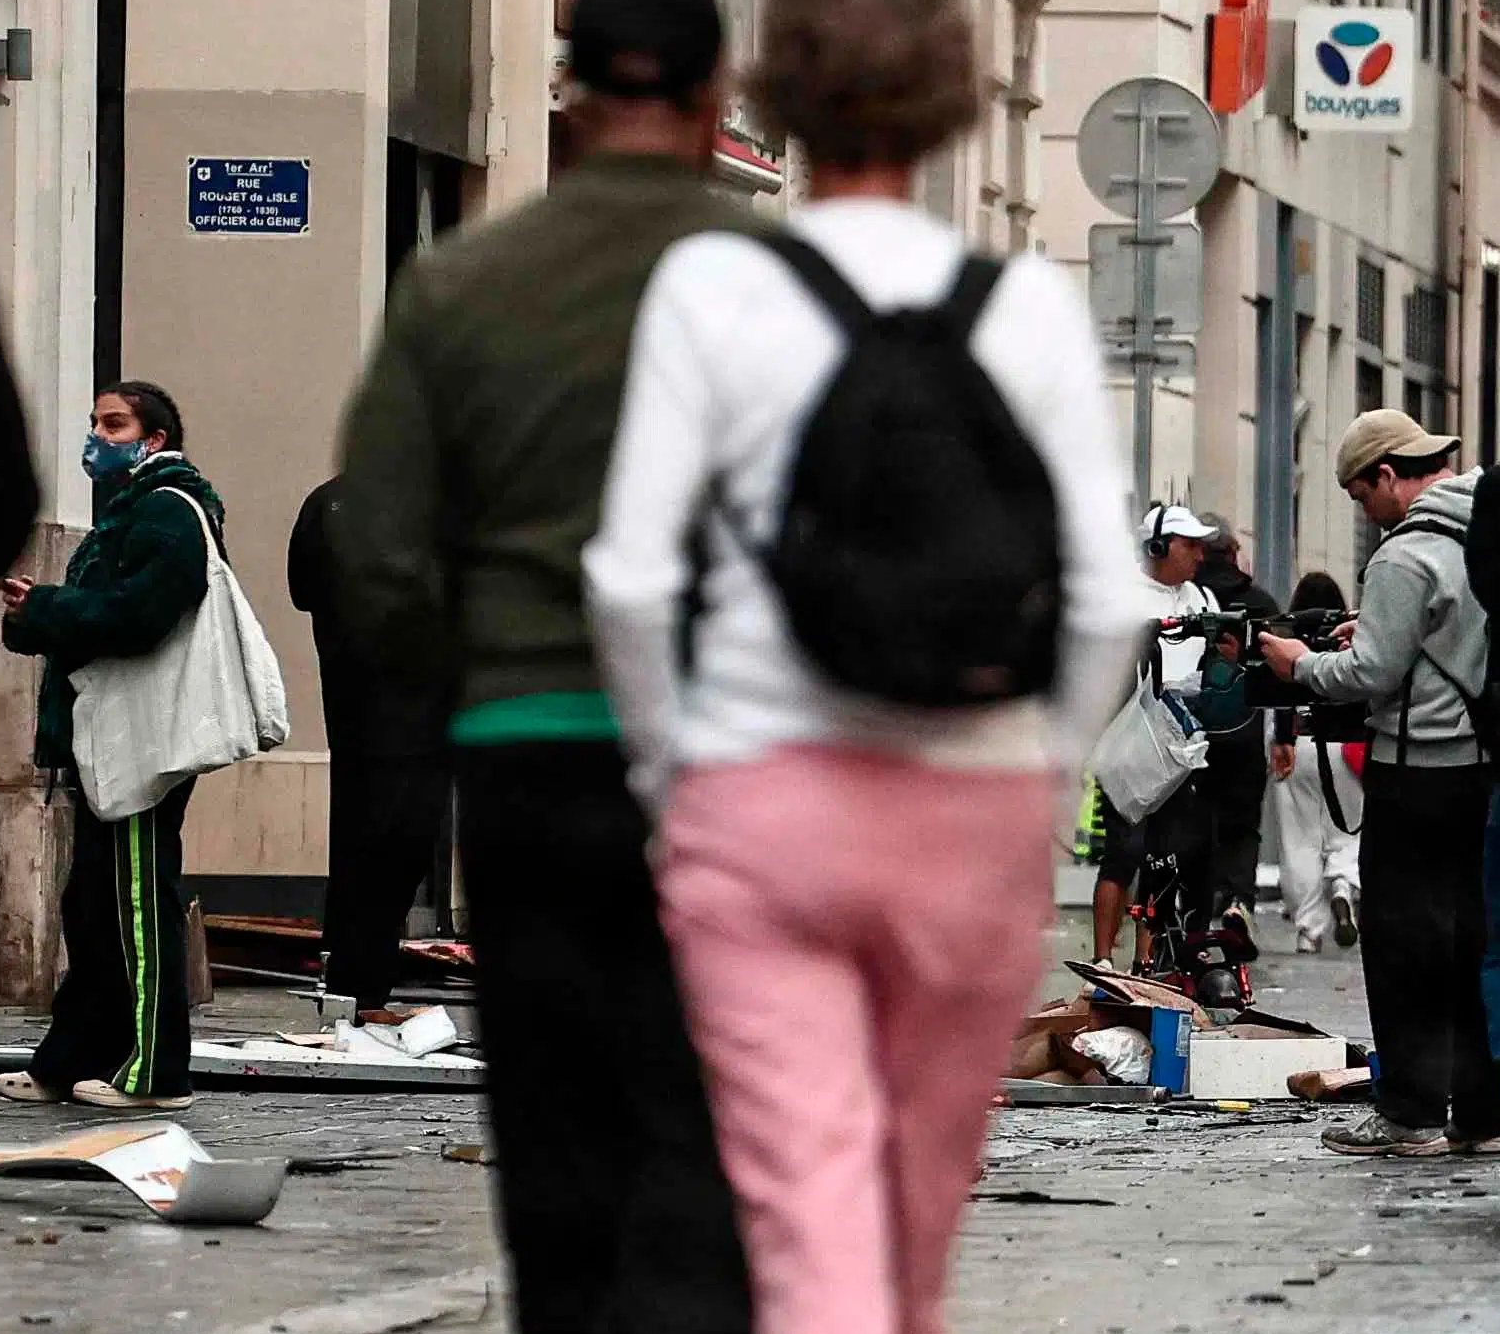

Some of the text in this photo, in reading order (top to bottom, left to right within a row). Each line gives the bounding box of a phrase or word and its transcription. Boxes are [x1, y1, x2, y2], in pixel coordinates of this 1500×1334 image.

[1304, 90, 1401, 119] bouygues
[236, 178, 261, 189] RUE
[199, 191, 298, 203] ROUGET de LISLE
[195, 215, 301, 227] OFFICIER du GENIE
